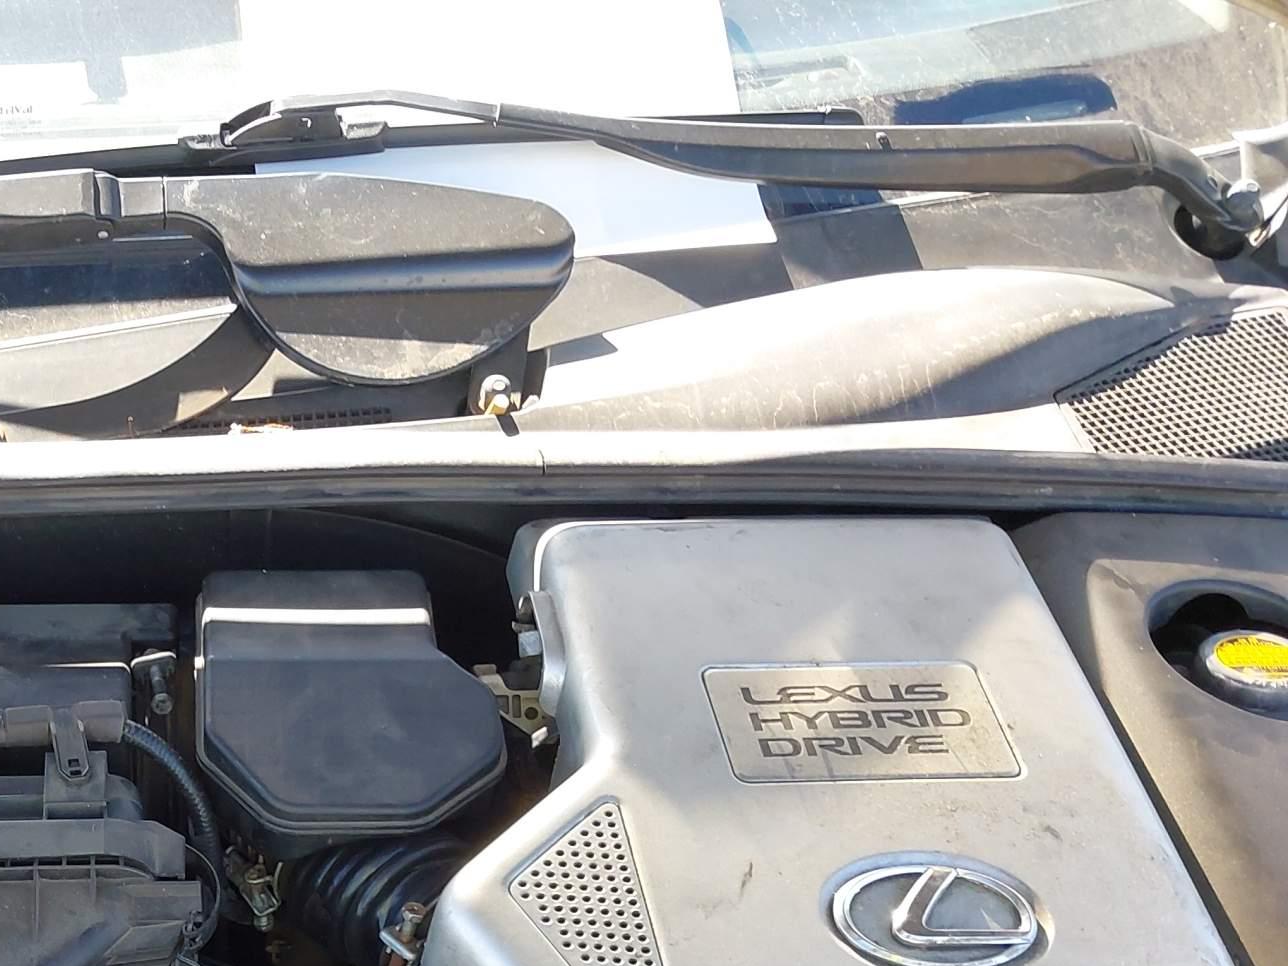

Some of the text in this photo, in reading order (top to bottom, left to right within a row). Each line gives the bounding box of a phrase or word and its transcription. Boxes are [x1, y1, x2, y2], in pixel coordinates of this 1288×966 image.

[740, 683, 949, 705] LEXUS
[749, 708, 972, 731] HYBRID
[759, 735, 949, 758] DRIVE
